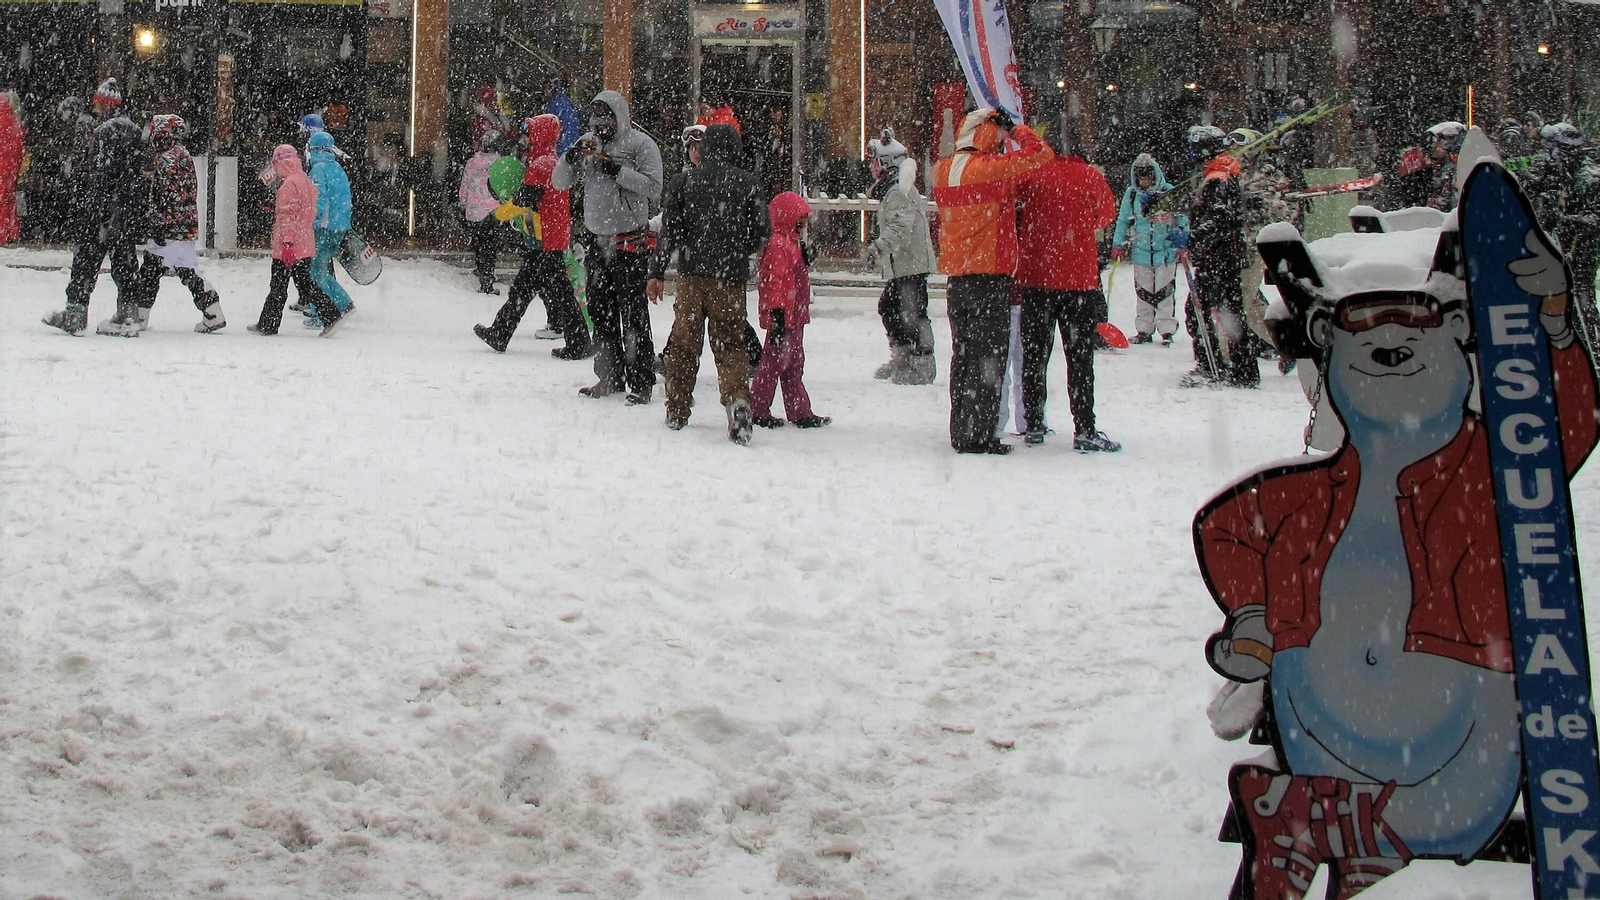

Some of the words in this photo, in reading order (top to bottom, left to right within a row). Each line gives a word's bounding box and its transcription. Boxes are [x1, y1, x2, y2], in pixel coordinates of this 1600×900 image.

[715, 17, 748, 32] Rio
[1488, 303, 1578, 676] ESCUELA
[1525, 705, 1588, 739] de
[1540, 768, 1600, 900] SK
